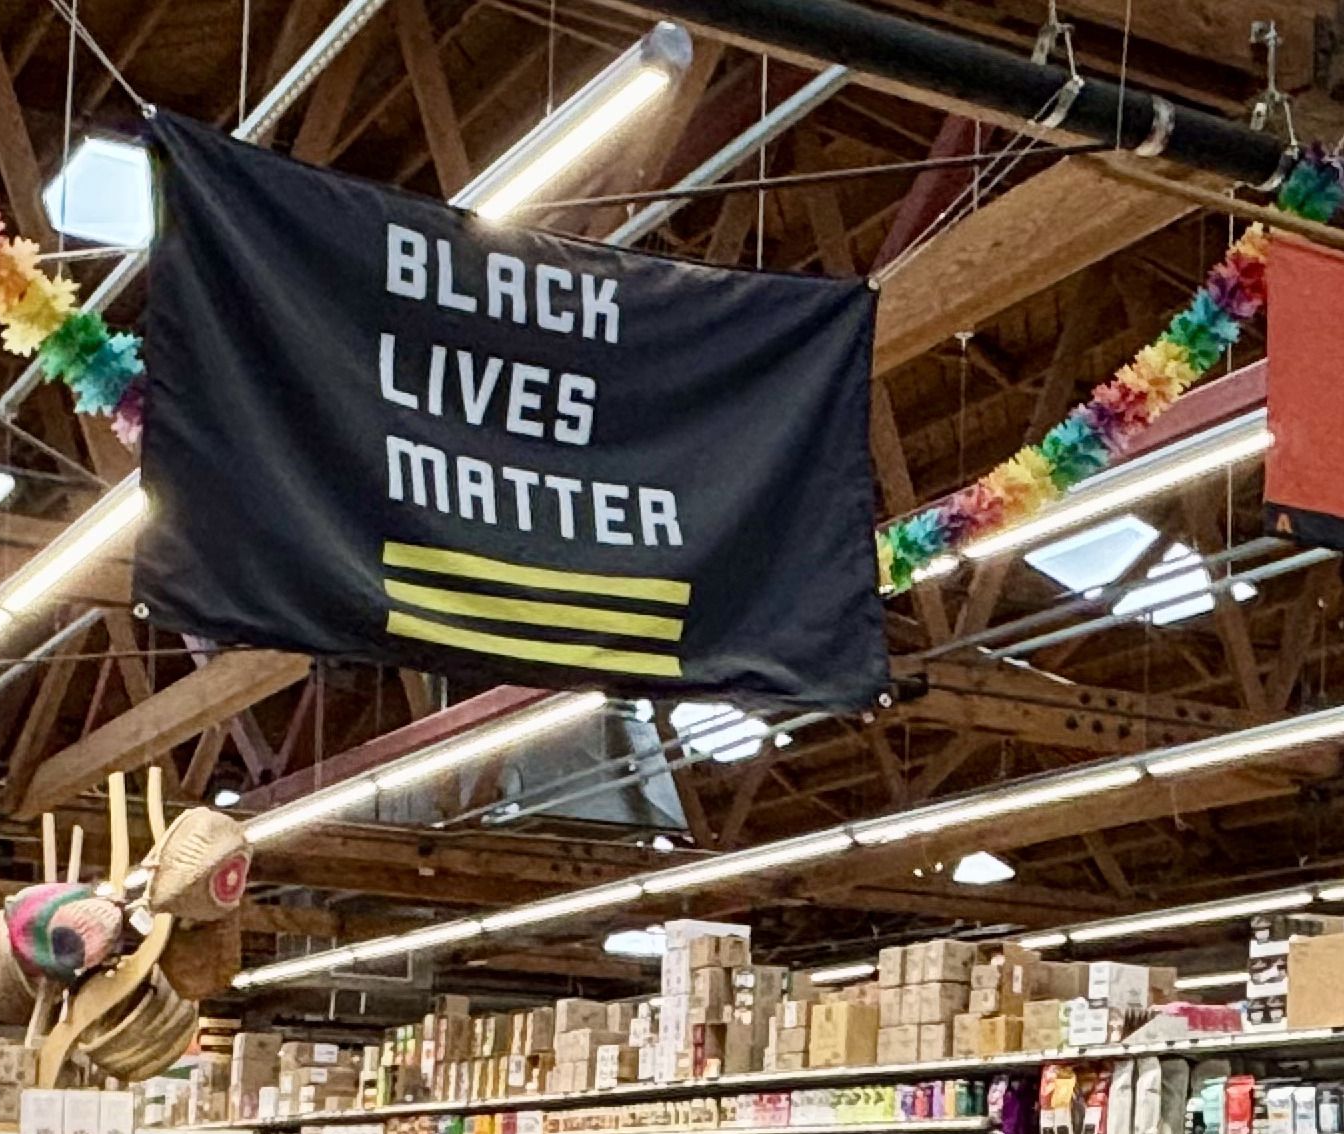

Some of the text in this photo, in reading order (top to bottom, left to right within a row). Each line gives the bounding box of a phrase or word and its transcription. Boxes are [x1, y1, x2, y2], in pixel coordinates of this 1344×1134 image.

[385, 221, 622, 345] BLACK
[379, 332, 598, 446] LIVES
[385, 434, 684, 547] MATTER
[1275, 512, 1293, 534] A
